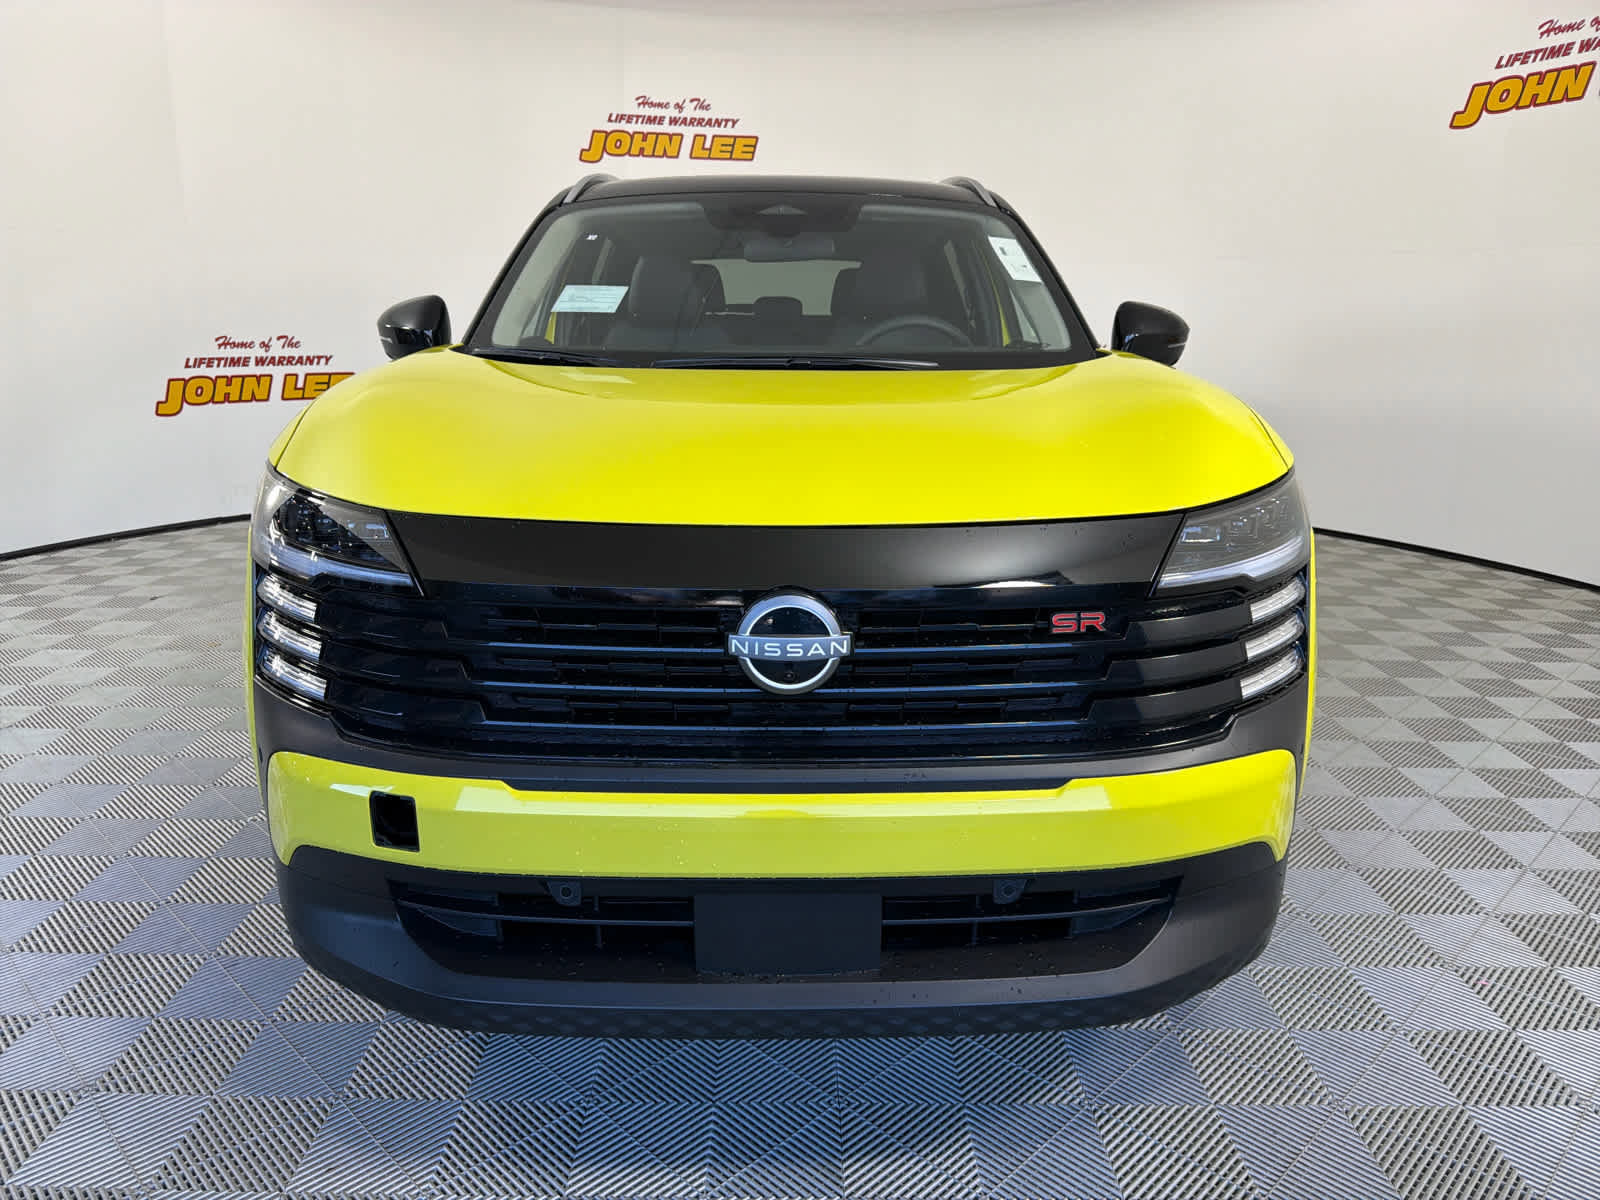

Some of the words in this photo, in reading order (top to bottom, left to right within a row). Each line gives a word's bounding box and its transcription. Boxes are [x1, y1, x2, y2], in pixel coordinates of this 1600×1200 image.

[1537, 19, 1586, 39] Home
[1494, 41, 1576, 69] LIFETIME
[635, 95, 670, 109] Home
[673, 99, 686, 114] of
[689, 98, 711, 111] The
[1449, 60, 1597, 129] JOHN
[607, 112, 666, 126] LIFETIME
[668, 115, 740, 129] WARRANTY
[579, 130, 683, 163] JOHN
[690, 134, 759, 161] LEE
[214, 335, 255, 350] Home
[259, 337, 272, 352] of
[276, 335, 301, 350] The
[184, 356, 250, 369] LIFETIME
[254, 355, 333, 367] WARRANTY
[155, 374, 273, 417] JOHN
[1051, 611, 1106, 633] SR
[731, 639, 848, 657] NISSAN
